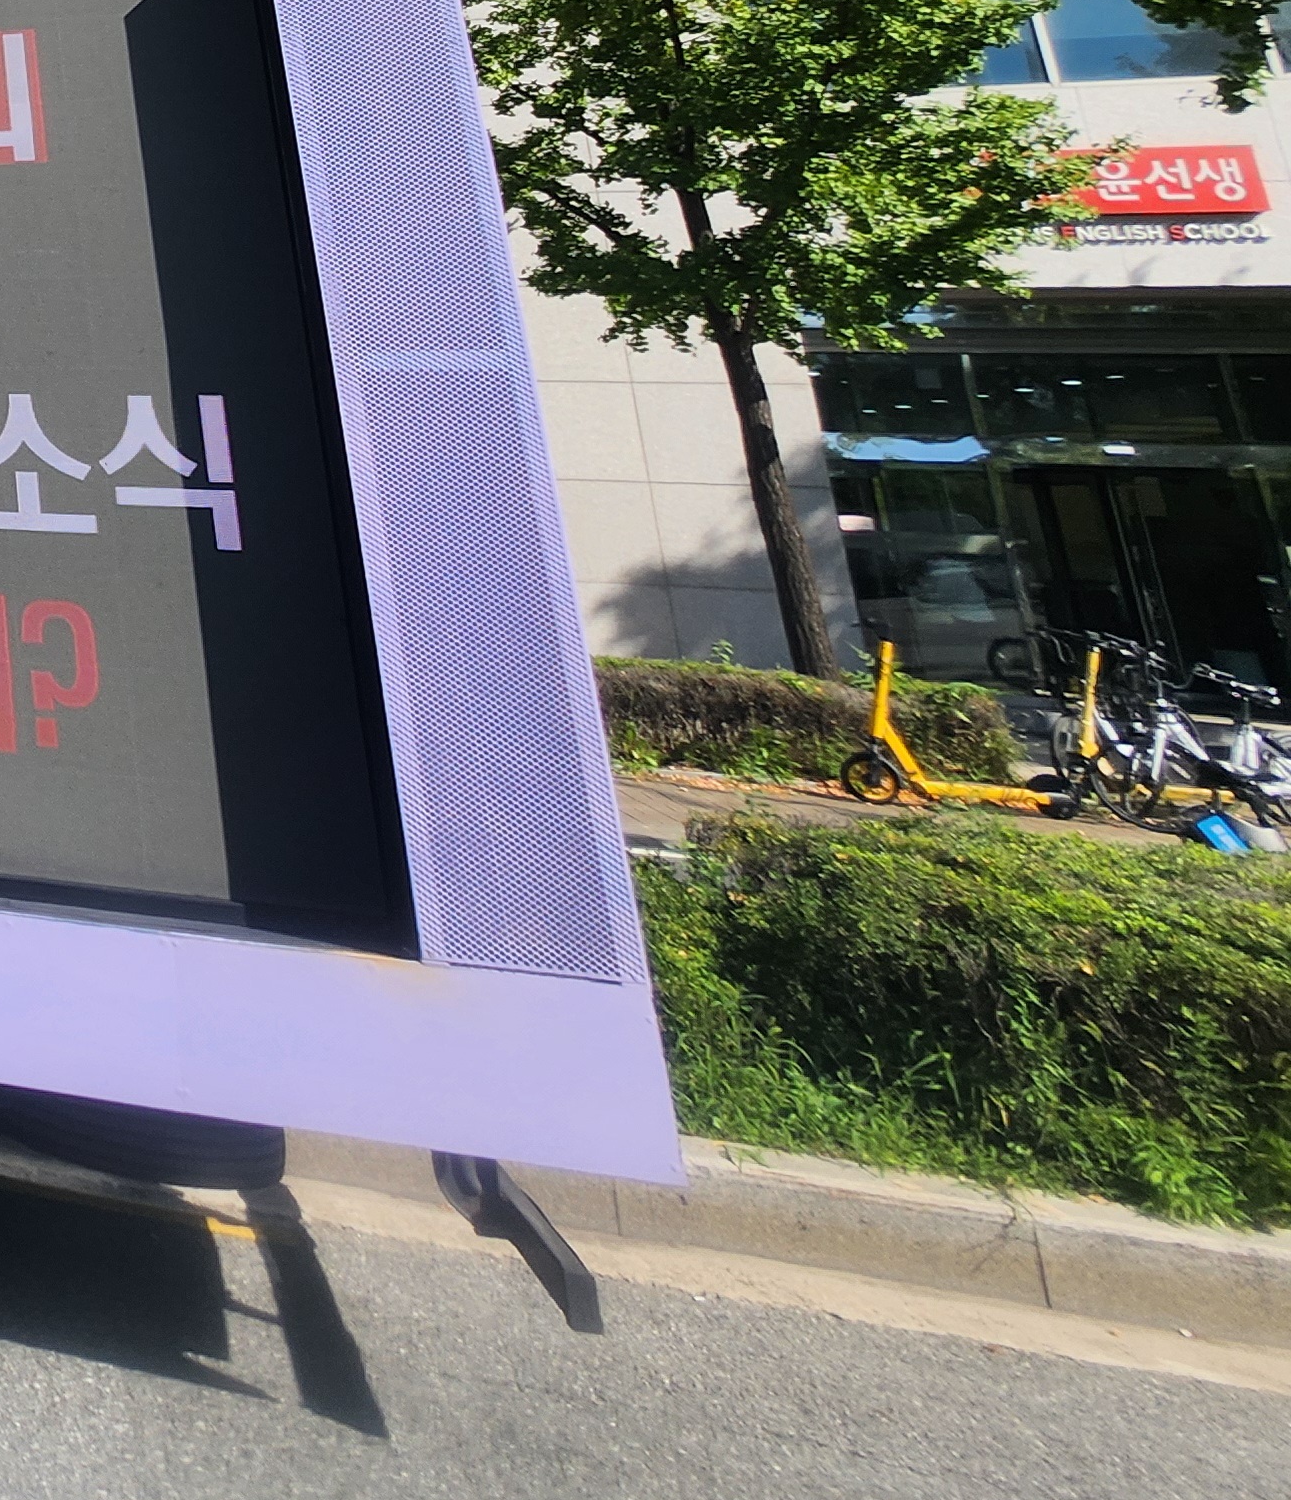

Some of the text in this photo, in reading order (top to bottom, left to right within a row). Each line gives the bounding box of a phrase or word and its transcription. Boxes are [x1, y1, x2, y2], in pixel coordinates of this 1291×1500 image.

[1095, 156, 1248, 203] 윤선생
[1060, 223, 1166, 241] ENGLISH
[1169, 223, 1272, 241] SCHOOL
